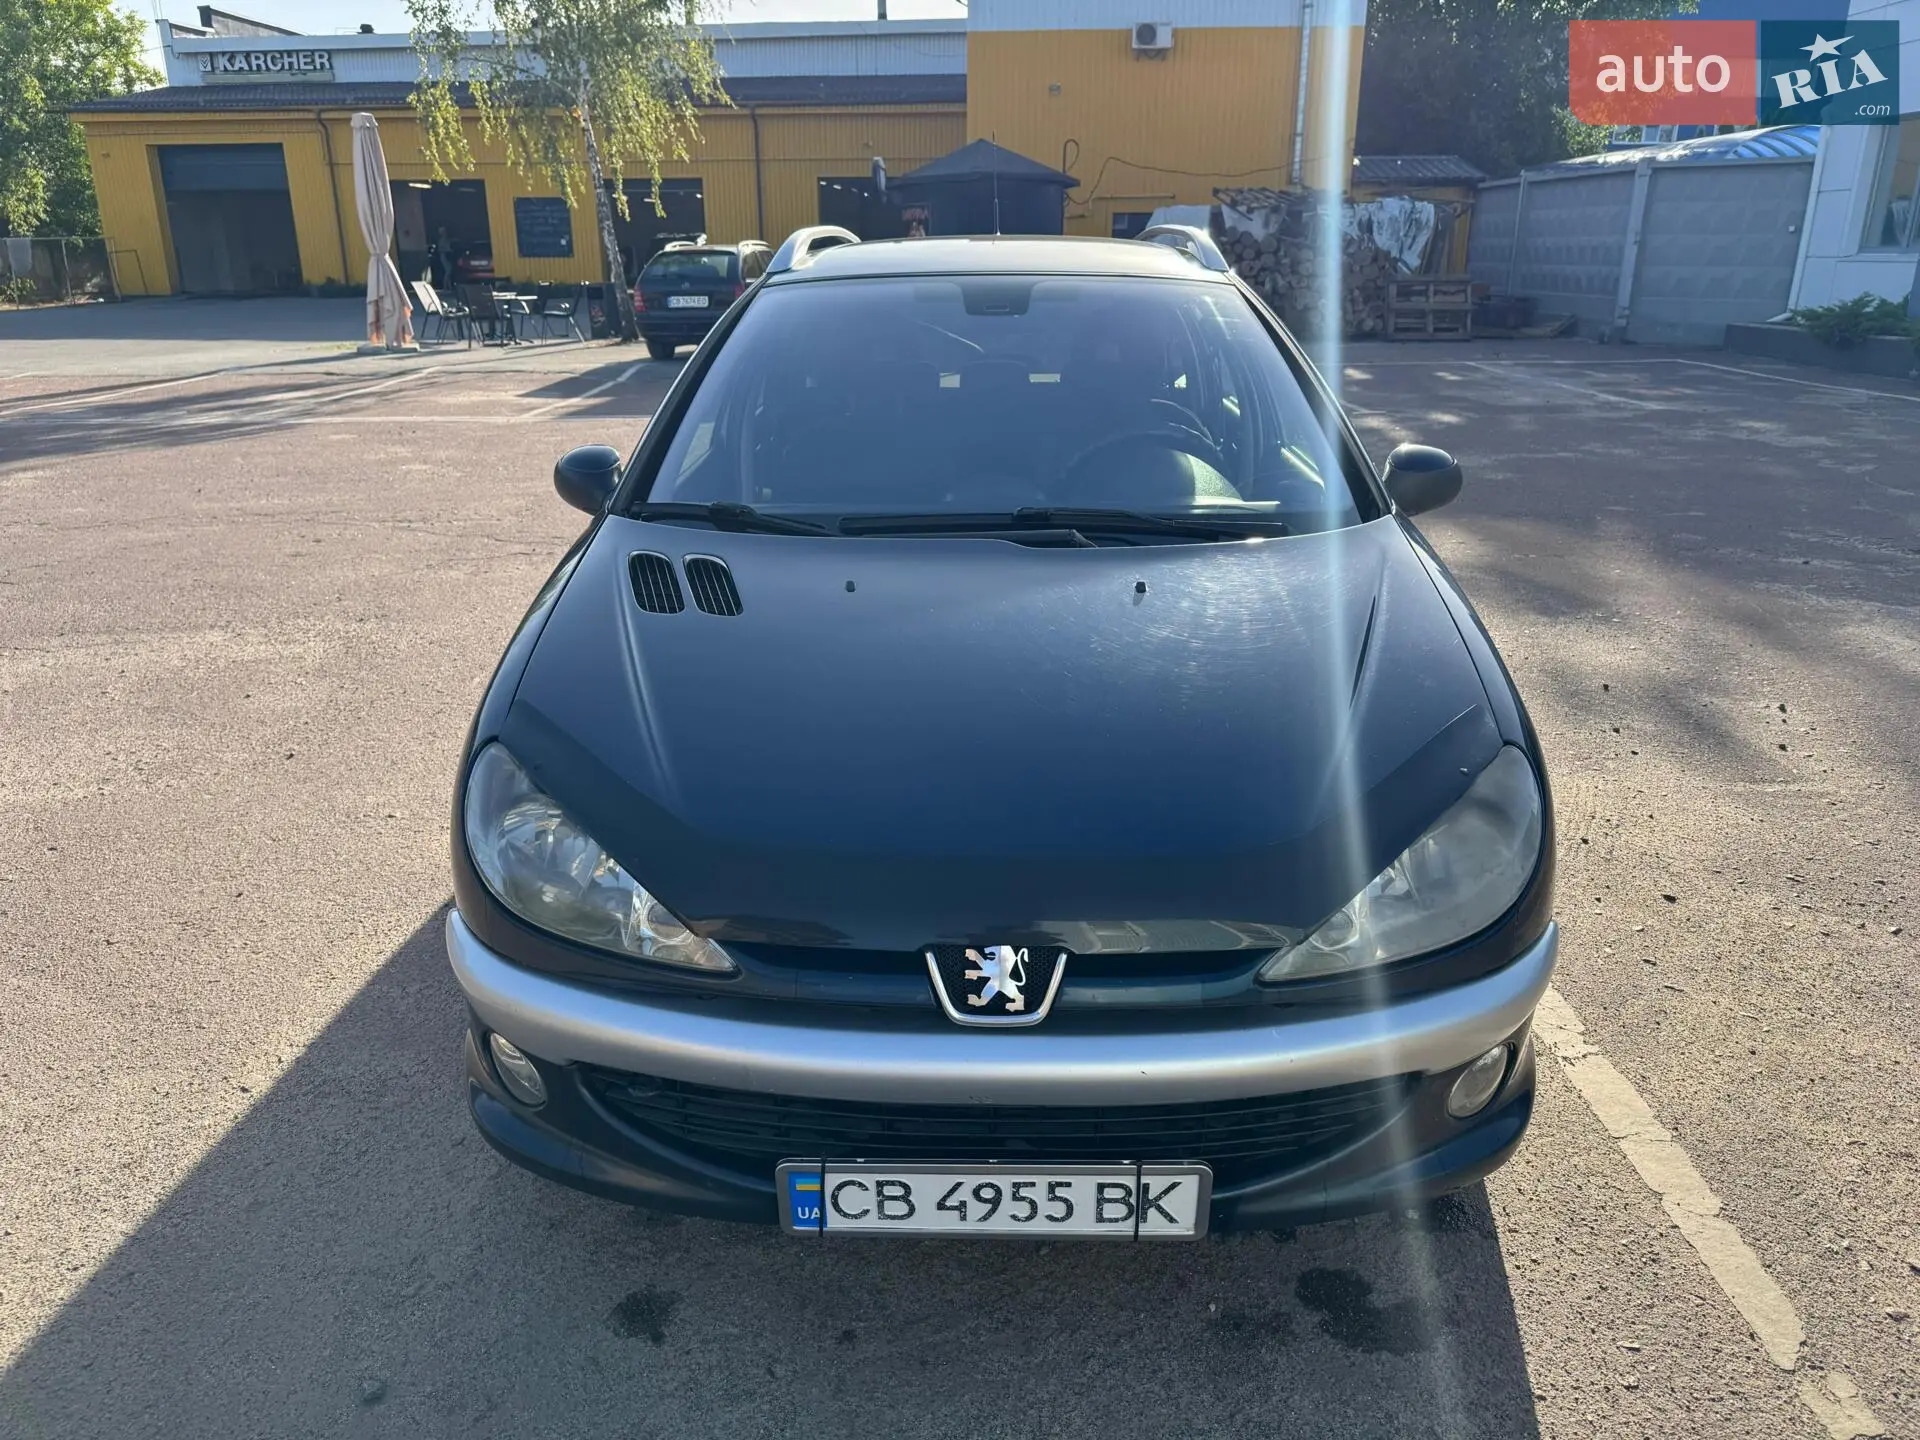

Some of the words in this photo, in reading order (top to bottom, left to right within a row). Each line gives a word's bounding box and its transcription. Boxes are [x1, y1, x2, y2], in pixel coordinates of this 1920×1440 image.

[797, 1206, 822, 1220] UA
[830, 1179, 916, 1221] CB
[936, 1181, 1074, 1223] 4955
[1095, 1181, 1183, 1224] BK
